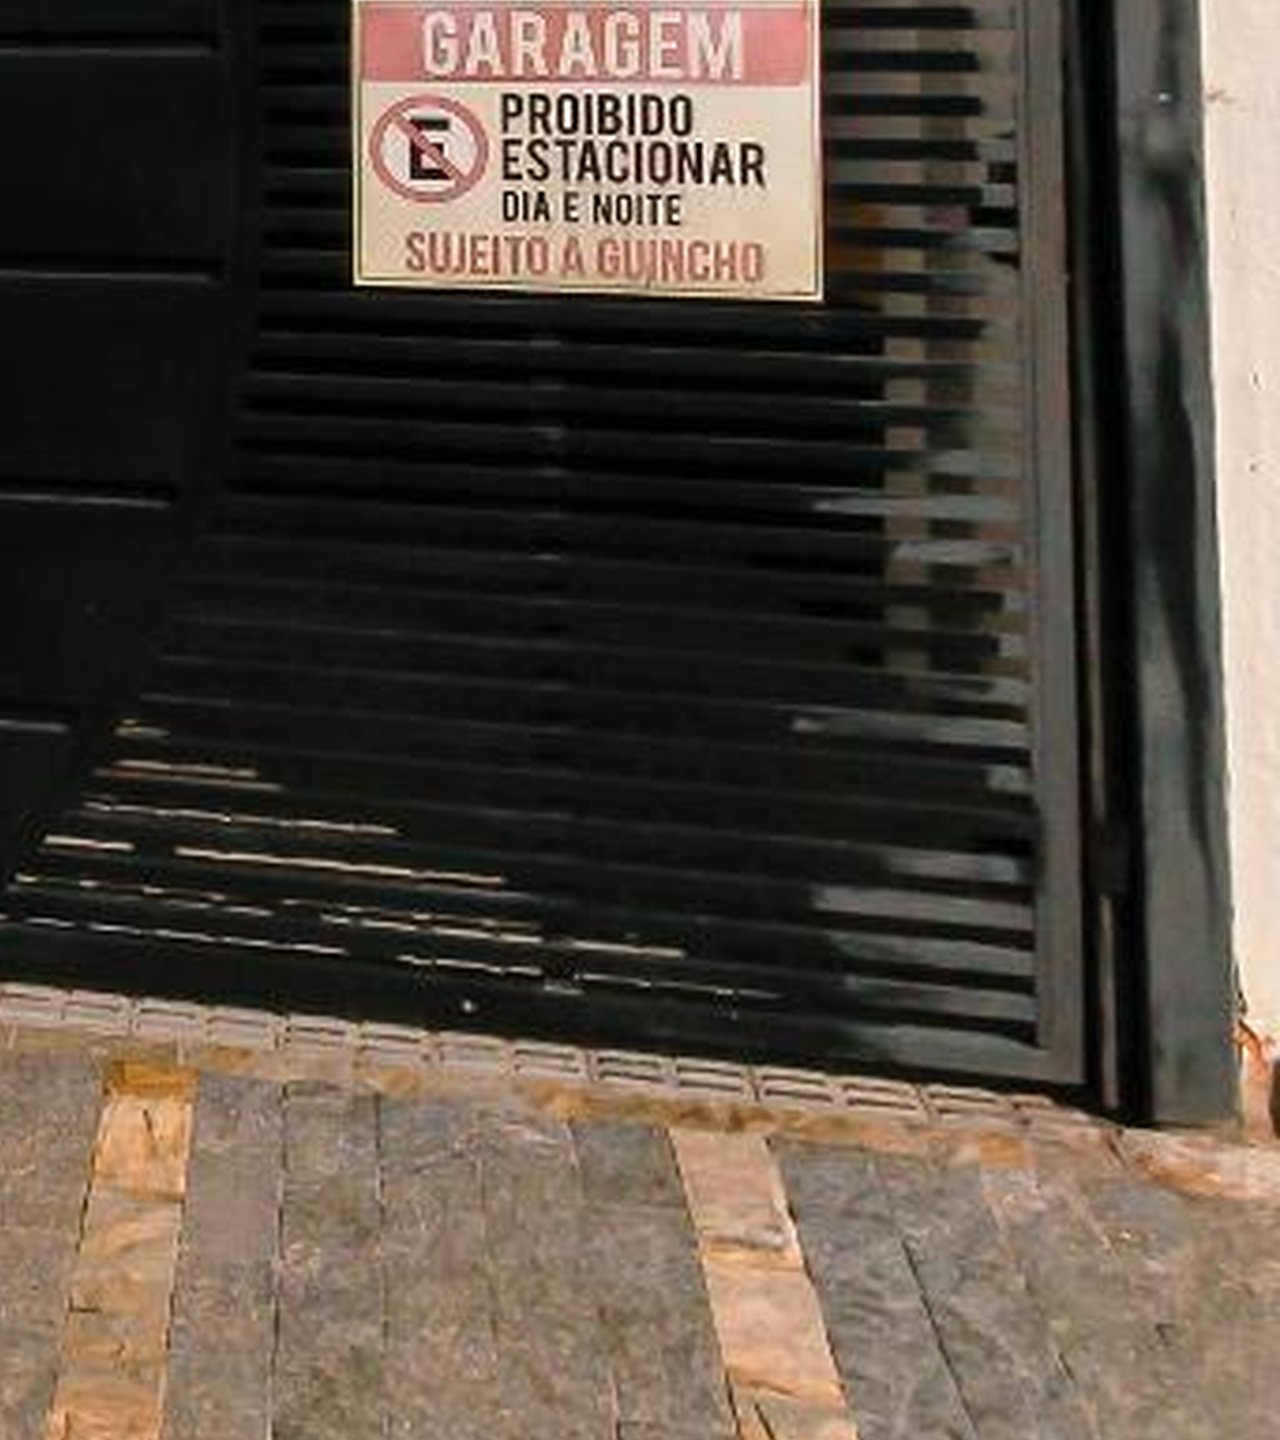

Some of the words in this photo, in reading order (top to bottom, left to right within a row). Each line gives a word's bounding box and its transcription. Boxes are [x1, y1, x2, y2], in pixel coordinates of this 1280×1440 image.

[422, 9, 743, 80] GARAGEM
[500, 93, 694, 137] PROIBIDO
[500, 138, 767, 188] ESTACIONAR
[501, 190, 550, 223] DIA
[562, 191, 580, 223] E
[592, 193, 683, 226] NOITE
[404, 231, 550, 277] SUJEITO
[559, 236, 587, 277] A
[596, 238, 765, 286] GUINCHO
